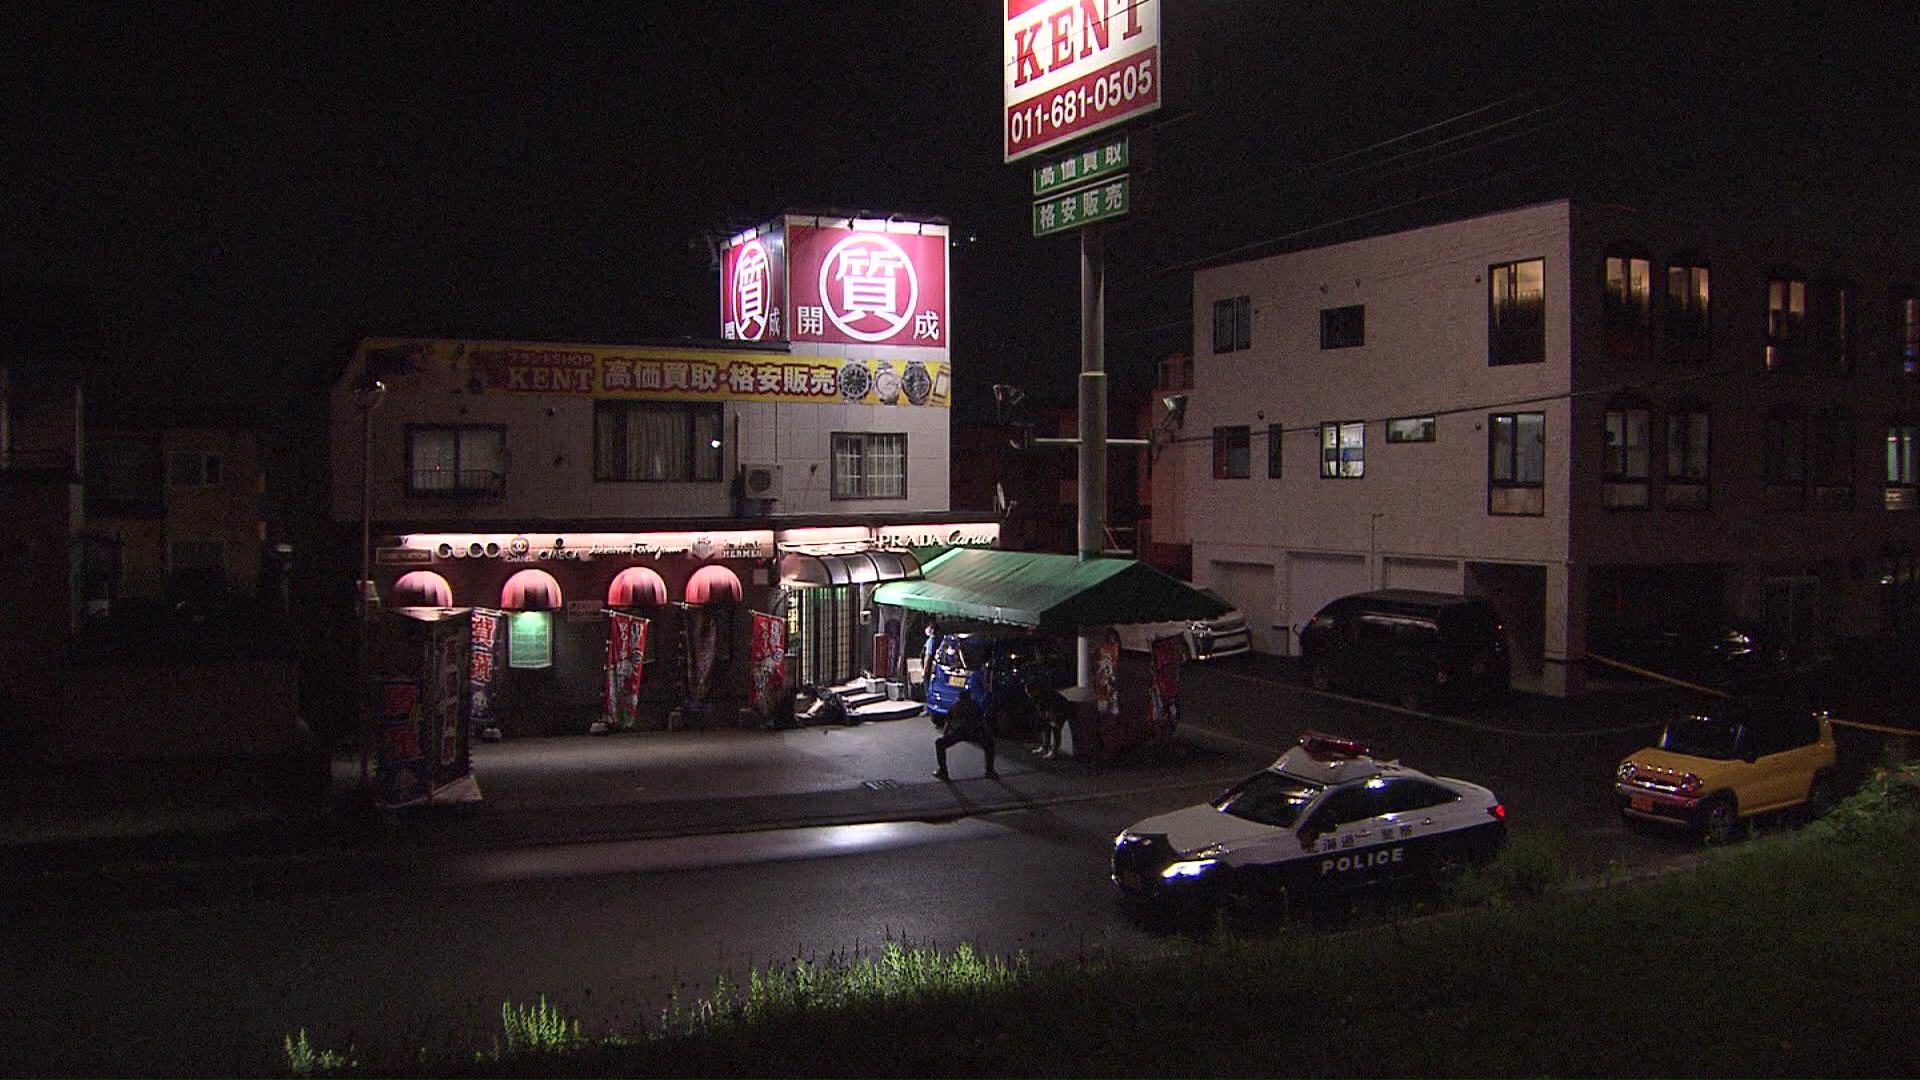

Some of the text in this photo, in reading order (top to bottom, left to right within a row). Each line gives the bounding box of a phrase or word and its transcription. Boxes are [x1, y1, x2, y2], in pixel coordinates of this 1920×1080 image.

[1014, 0, 1142, 88] KENT
[1011, 59, 1153, 144] 011-681-0505
[1040, 184, 1122, 229] 格安販売
[835, 246, 906, 328] 質
[508, 367, 593, 392] KENT
[877, 533, 944, 548] PRADA
[1321, 847, 1404, 874] POLICE
